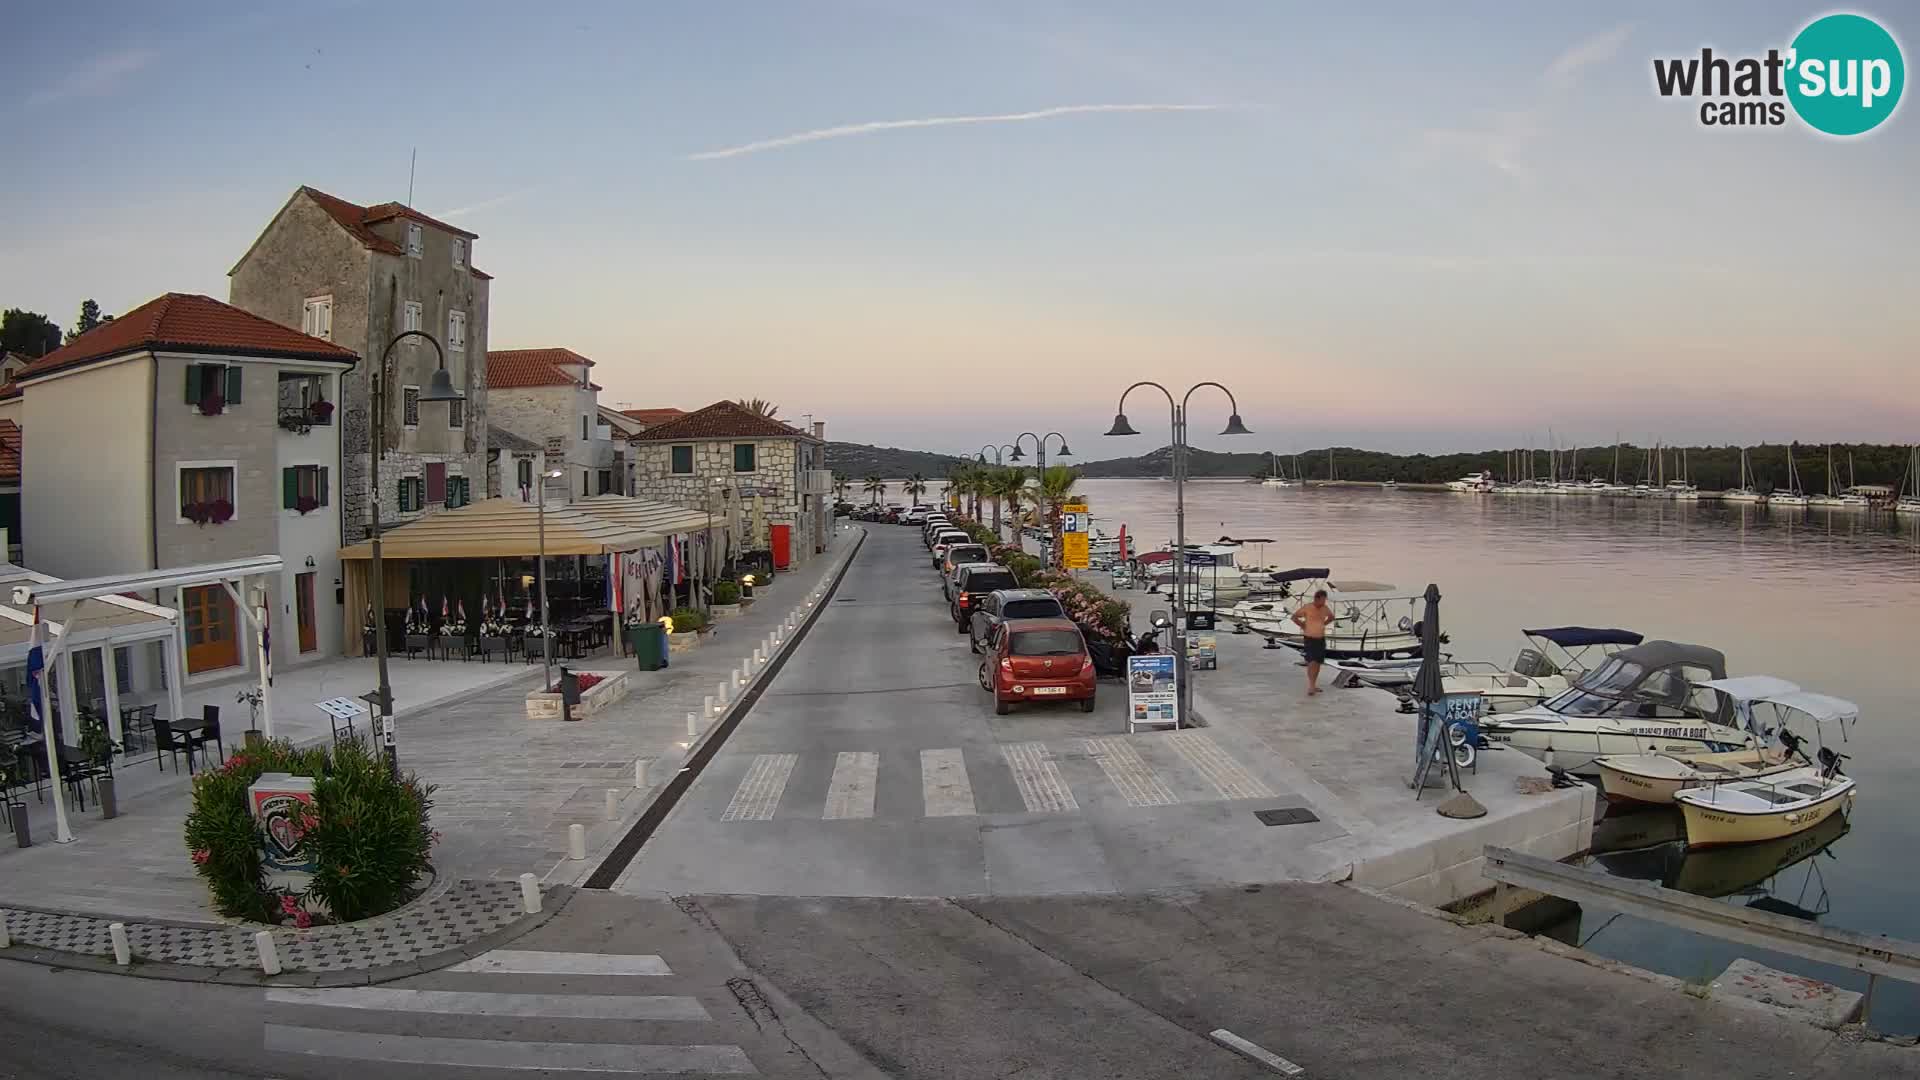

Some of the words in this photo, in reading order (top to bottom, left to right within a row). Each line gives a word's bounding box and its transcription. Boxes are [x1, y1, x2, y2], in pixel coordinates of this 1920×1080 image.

[1065, 514, 1076, 531] P
[1447, 698, 1479, 711] RENT
[1446, 711, 1453, 720] A
[1455, 710, 1477, 719] BOAT
[1663, 727, 1682, 737] RENT
[1683, 728, 1689, 738] A
[1690, 728, 1708, 739] BOAT
